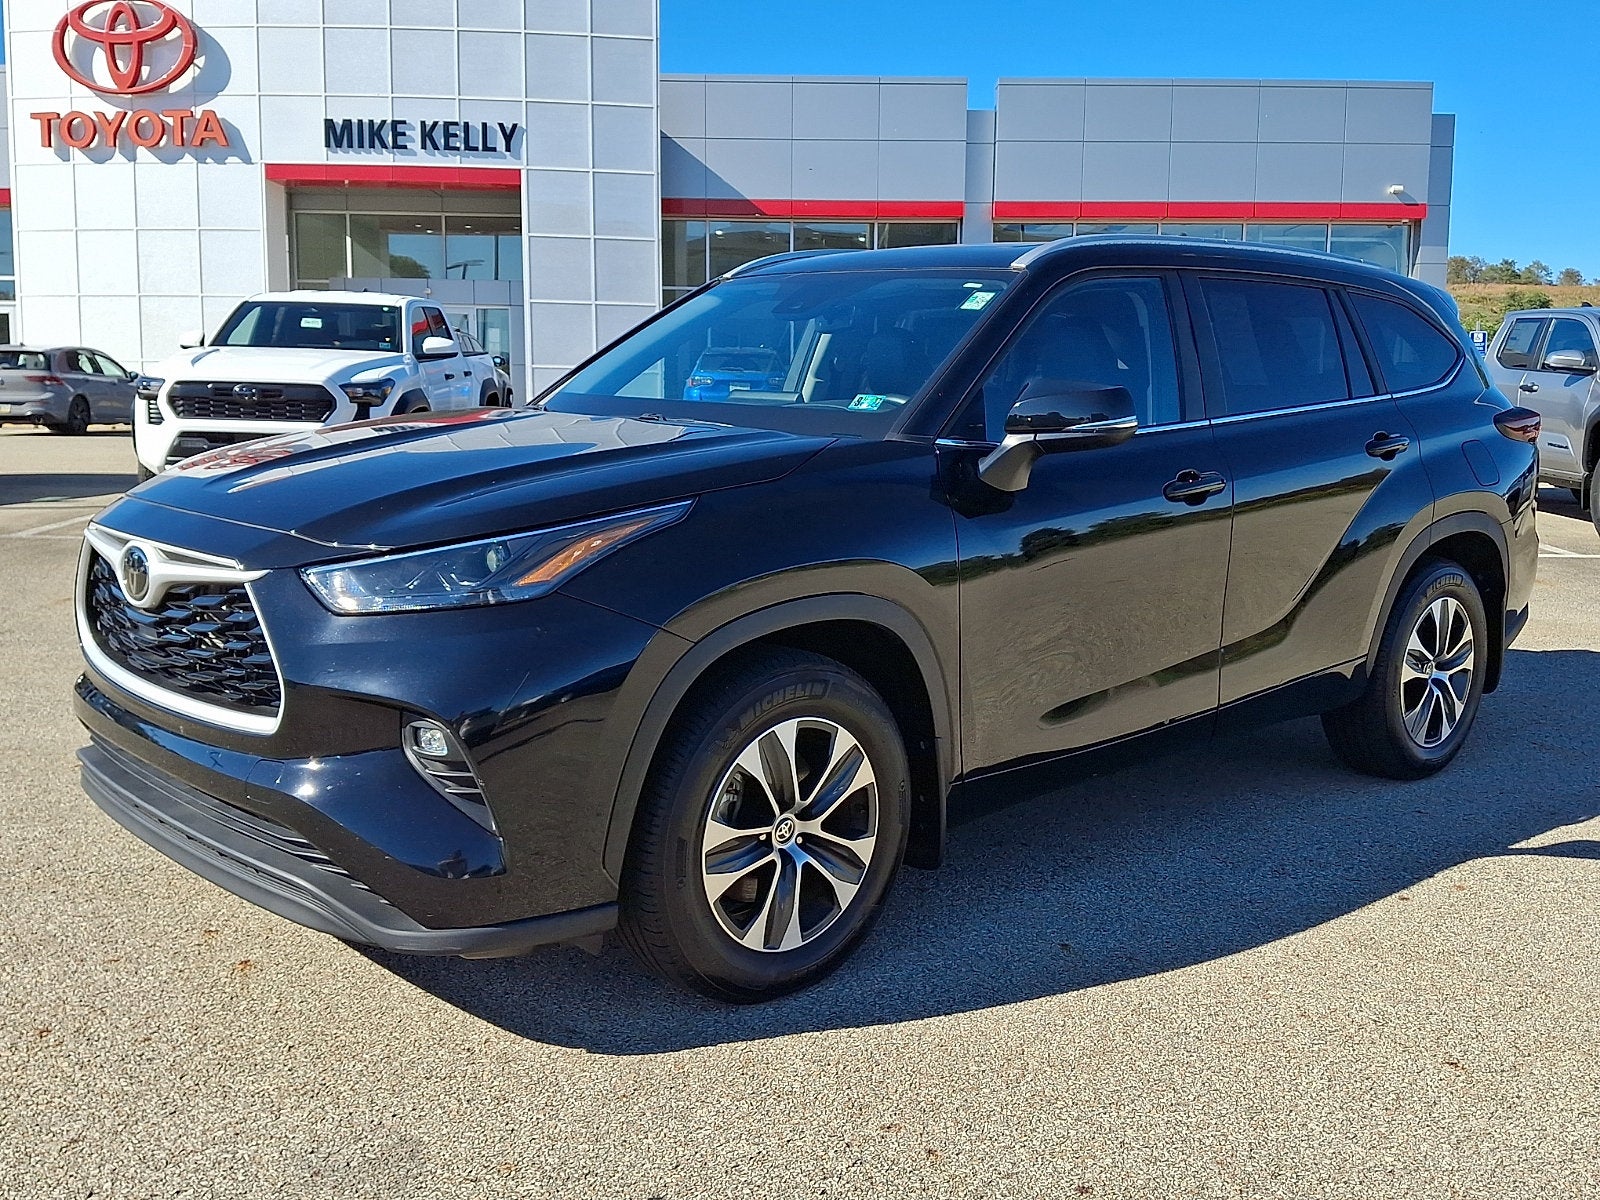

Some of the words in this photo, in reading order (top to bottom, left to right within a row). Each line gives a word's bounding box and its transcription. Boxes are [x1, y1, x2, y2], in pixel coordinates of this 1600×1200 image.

[30, 109, 229, 148] TOYOTA
[324, 118, 409, 150] MIKE
[420, 120, 519, 153] KELLY
